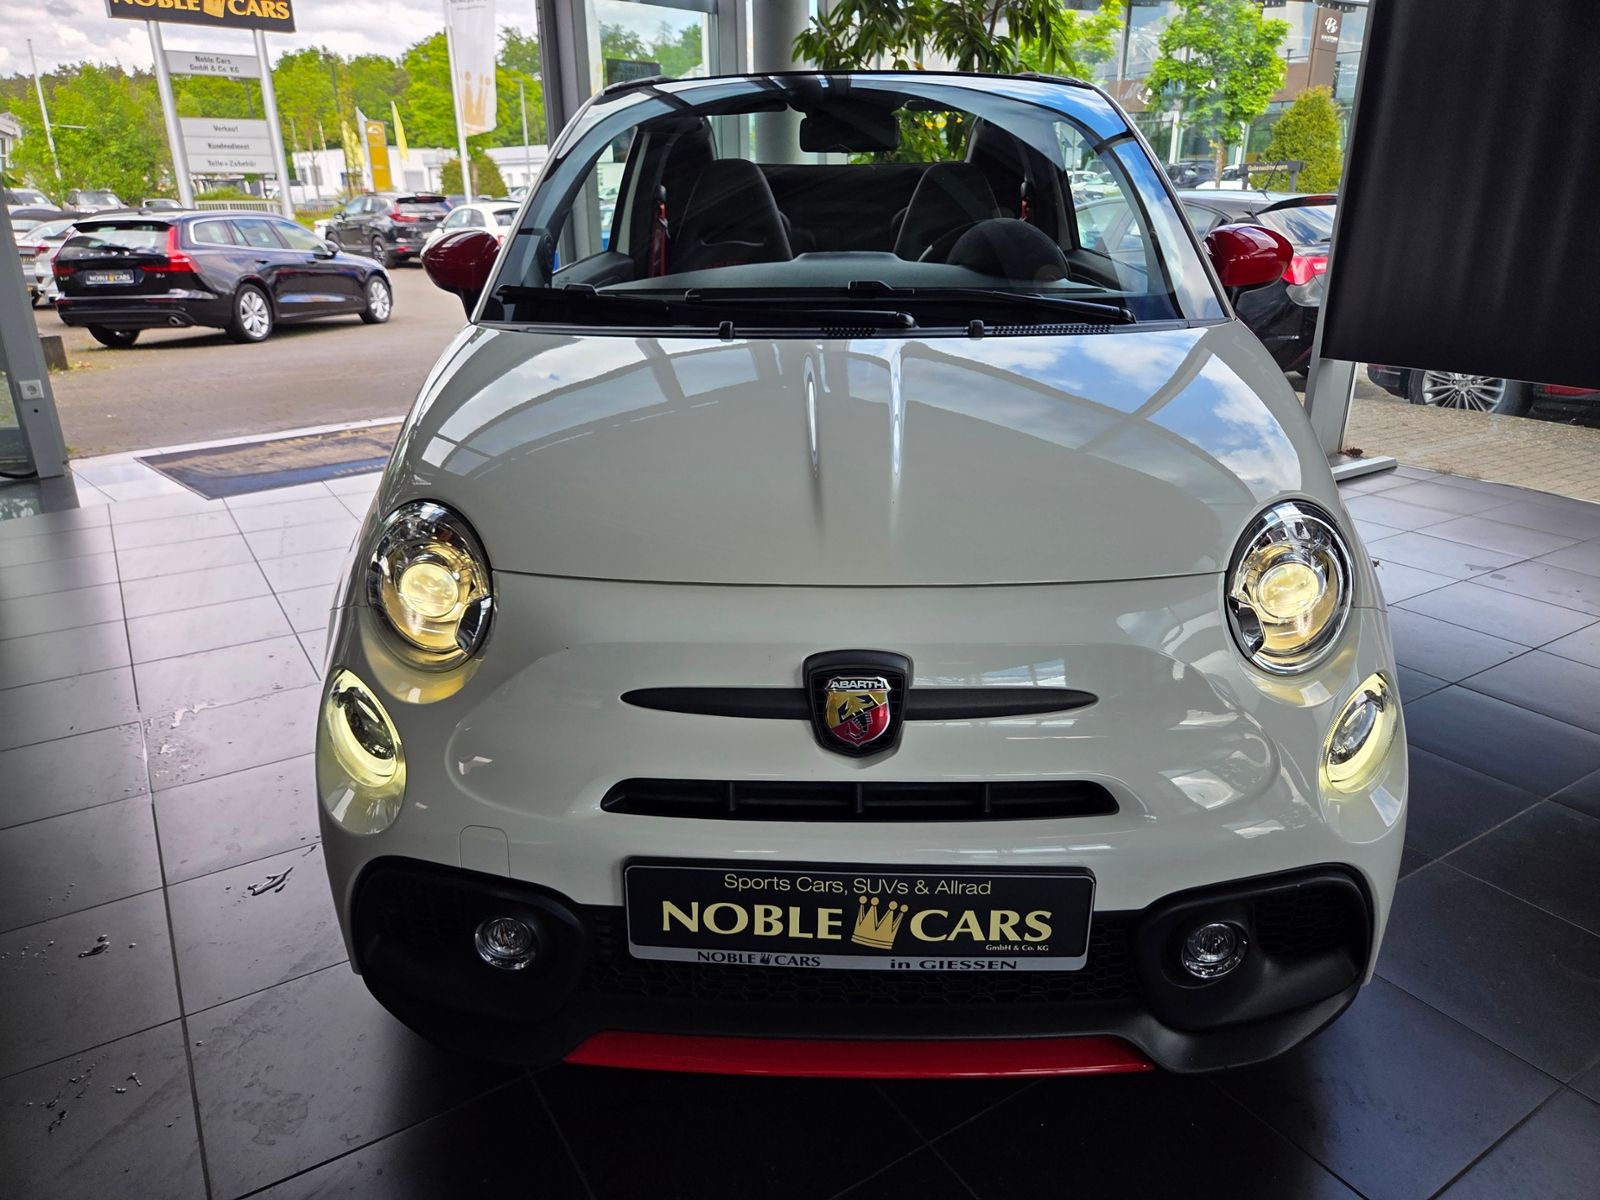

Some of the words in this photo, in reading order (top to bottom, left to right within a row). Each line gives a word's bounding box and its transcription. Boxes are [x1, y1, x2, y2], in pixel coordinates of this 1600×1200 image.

[227, 0, 290, 19] CARS
[830, 680, 884, 689] ABARTH
[724, 873, 791, 892] Sports
[796, 876, 848, 895] Cars,
[853, 878, 909, 894] SUVs
[914, 879, 930, 895] &
[934, 880, 992, 895] Allrad
[661, 900, 843, 940] NOBLE
[909, 909, 1053, 942] CARS
[697, 951, 756, 964] NOBLE
[774, 955, 821, 967] CARS
[890, 959, 911, 969] in
[918, 960, 1017, 970] GIESSEN
